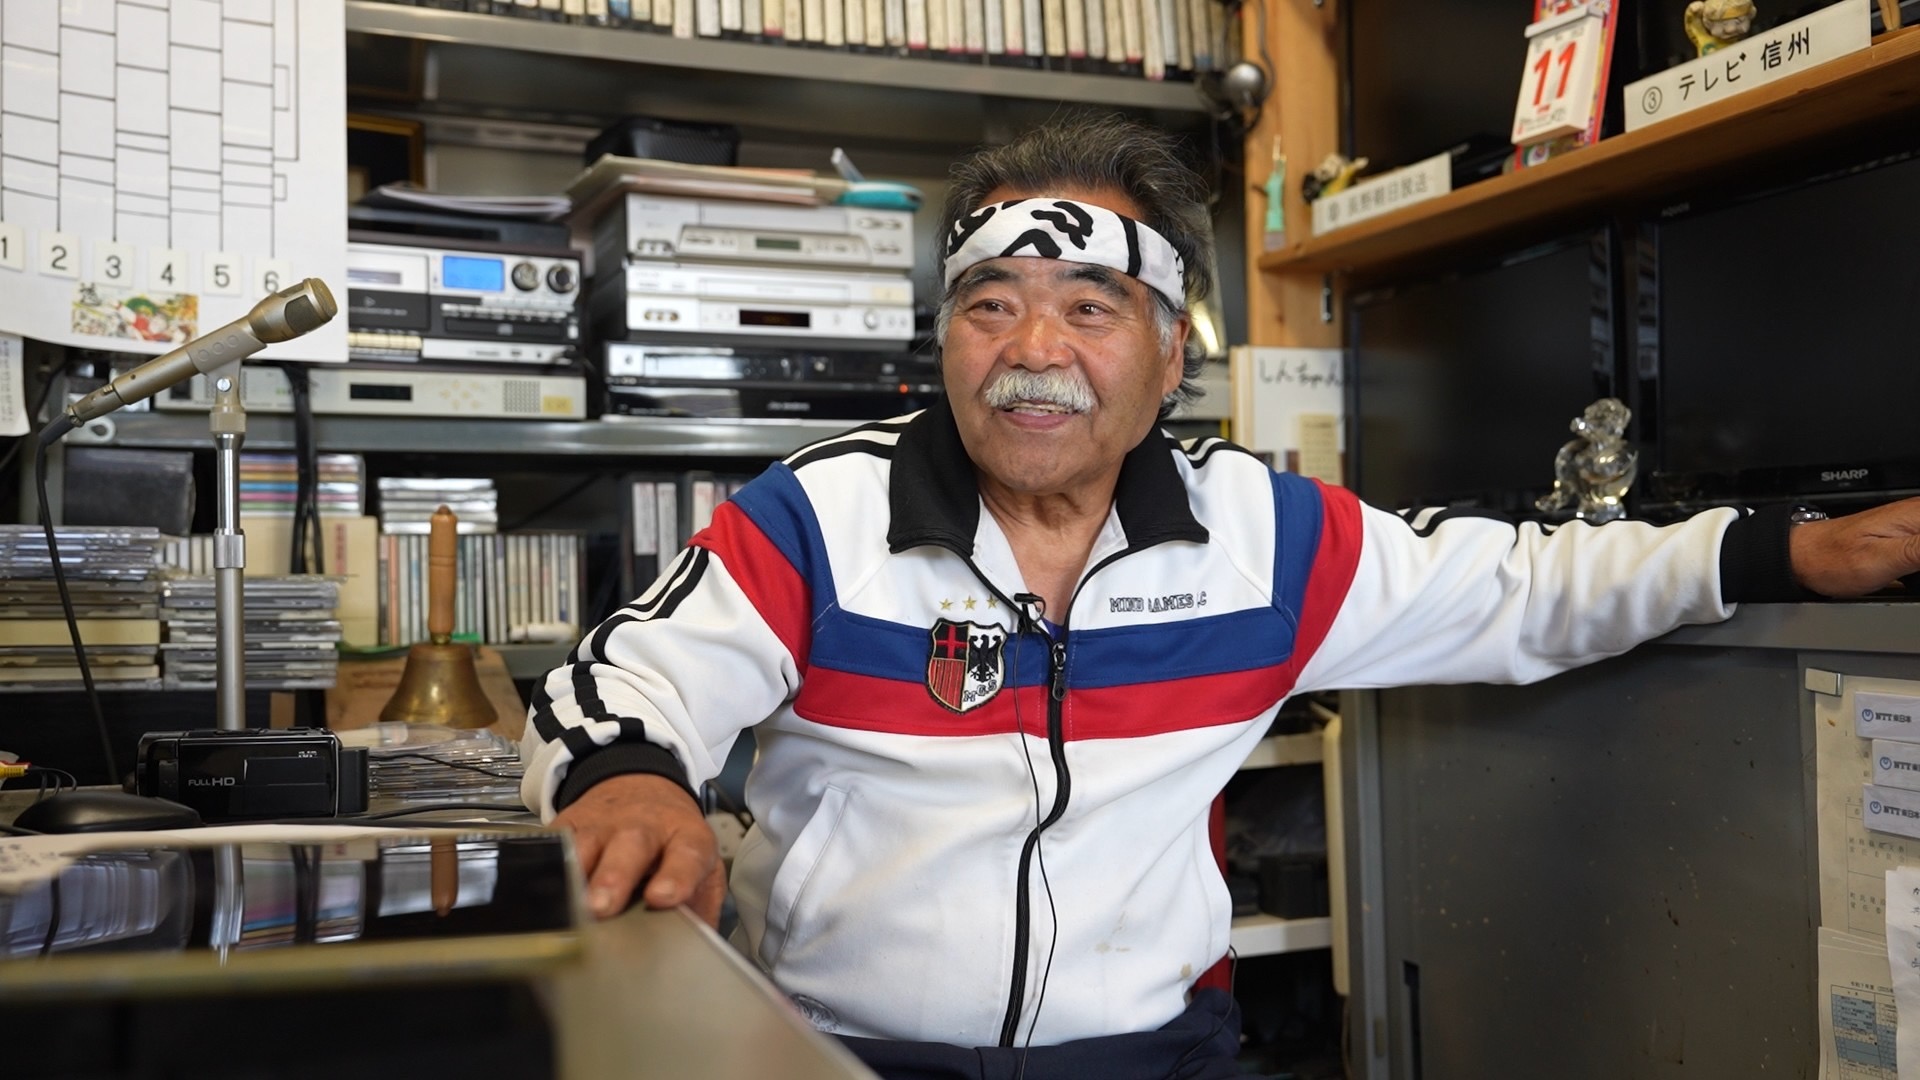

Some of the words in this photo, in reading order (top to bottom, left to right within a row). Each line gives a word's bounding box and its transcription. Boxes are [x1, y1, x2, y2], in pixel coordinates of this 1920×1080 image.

[1533, 41, 1577, 106] 11
[0, 236, 8, 259] 1
[51, 245, 68, 270] 2
[105, 255, 122, 279] 3
[160, 263, 176, 285] 4
[214, 264, 231, 288] 5
[264, 270, 280, 293] 6
[1821, 468, 1869, 482] SHARP
[1109, 596, 1145, 613] MIND
